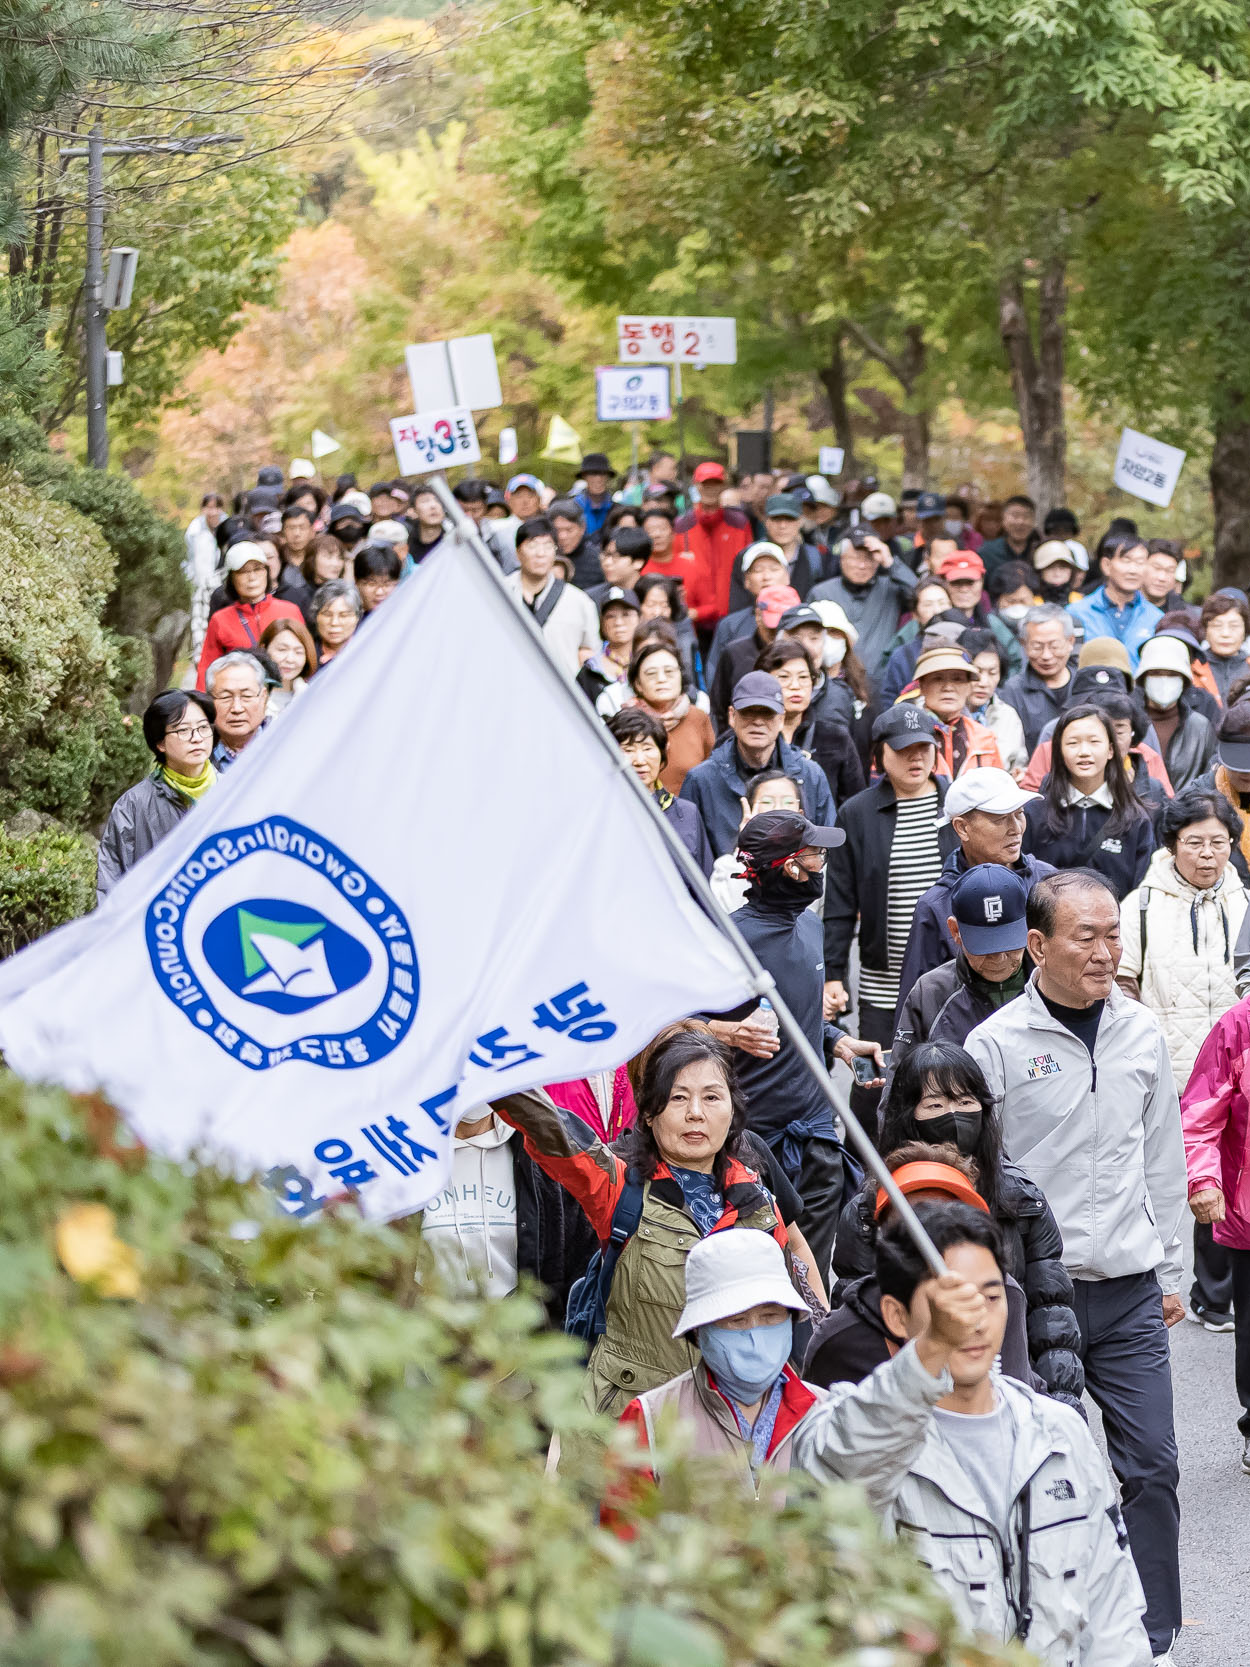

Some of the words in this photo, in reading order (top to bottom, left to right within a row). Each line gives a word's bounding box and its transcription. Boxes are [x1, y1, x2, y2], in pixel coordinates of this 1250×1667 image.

[399, 418, 471, 463] 자양3동
[1029, 1053, 1054, 1067] SEOUL
[1041, 1062, 1062, 1075] SOUL
